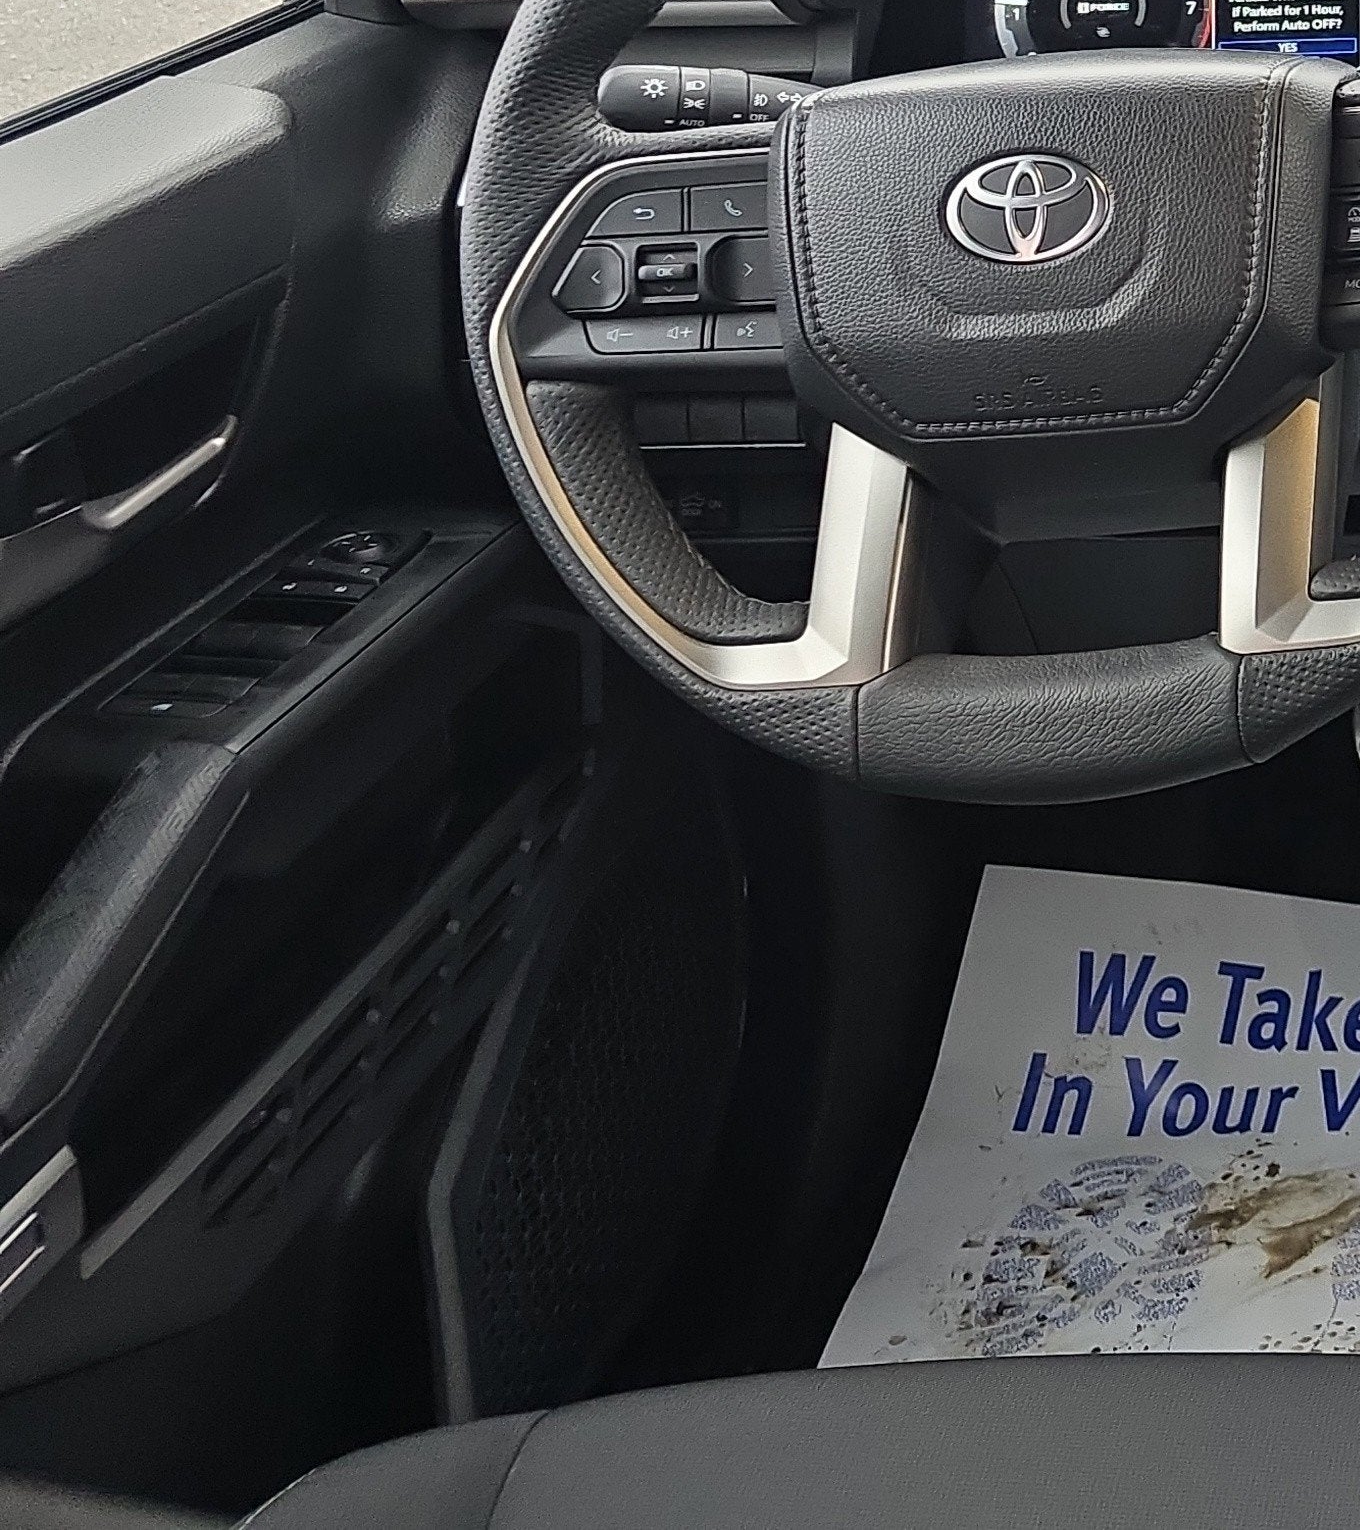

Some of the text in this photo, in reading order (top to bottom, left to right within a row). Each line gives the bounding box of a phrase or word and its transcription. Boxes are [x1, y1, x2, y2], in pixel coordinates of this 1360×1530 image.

[1012, 7, 1020, 20] 1
[1185, 1, 1197, 15] 7
[1232, 4, 1344, 18] If Parked for 1 Hour,
[1234, 19, 1343, 33] Perform Auto OFF?
[1277, 43, 1298, 53] YES
[679, 118, 706, 127] AUTO
[750, 113, 770, 122] OFF
[656, 267, 674, 278] OK
[1075, 950, 1189, 1038] We
[1011, 1052, 1092, 1136] In
[1125, 1058, 1298, 1138] Your
